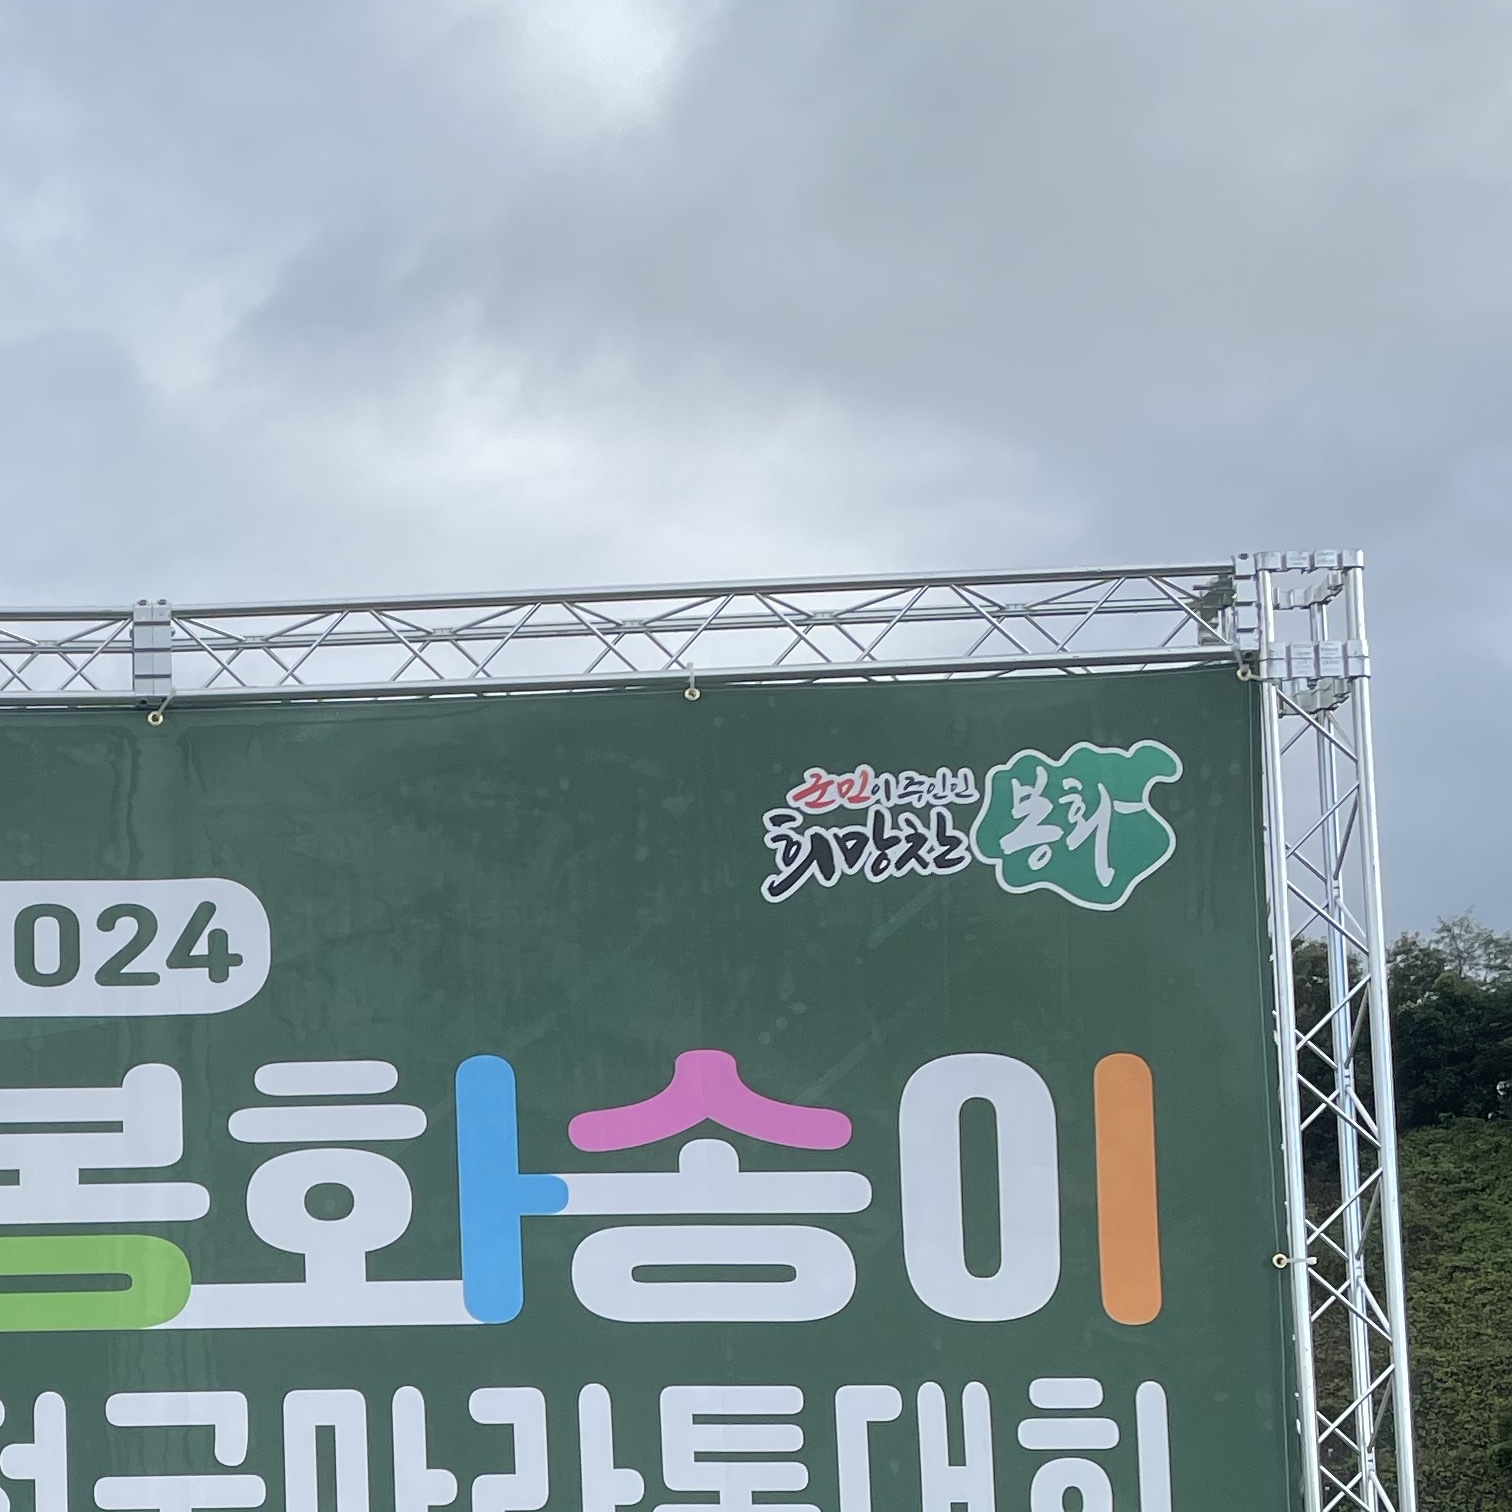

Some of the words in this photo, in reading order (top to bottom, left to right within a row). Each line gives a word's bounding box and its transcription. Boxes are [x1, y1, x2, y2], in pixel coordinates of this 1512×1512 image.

[766, 809, 969, 898] 희망찬
[999, 764, 1148, 887] 봉화
[791, 769, 890, 809] 군민이
